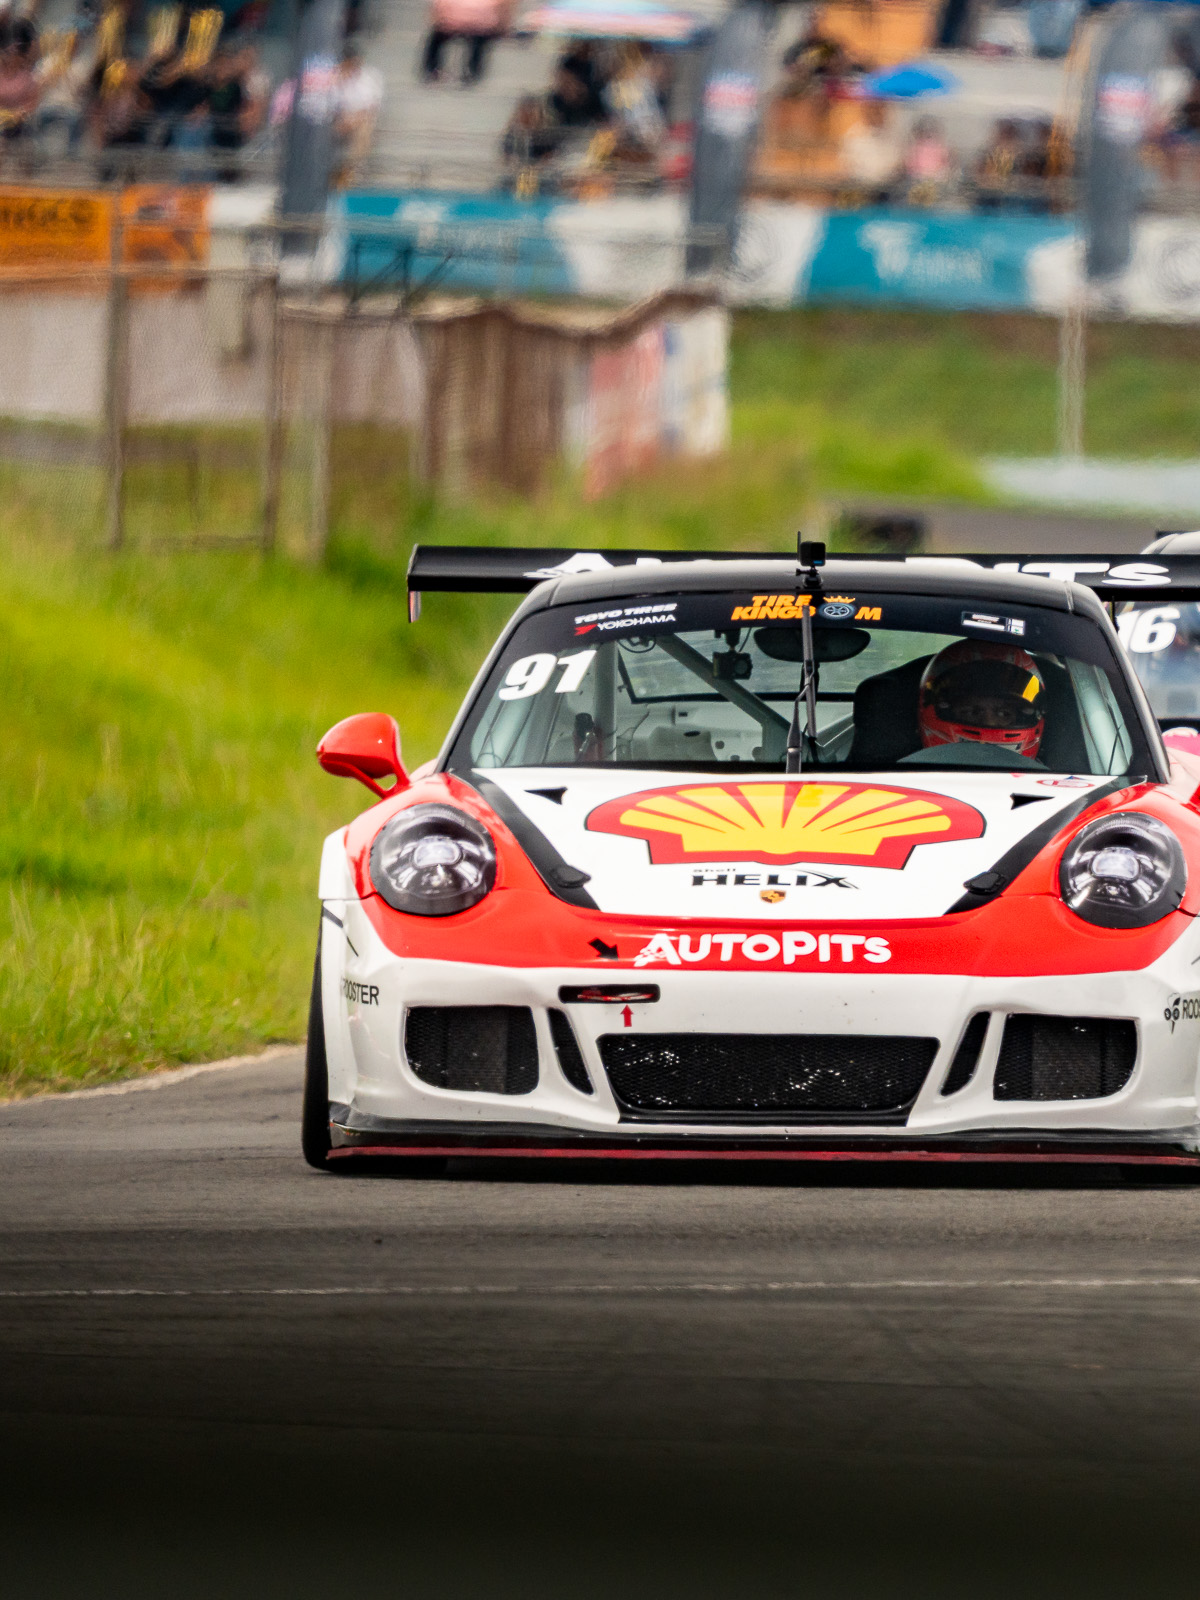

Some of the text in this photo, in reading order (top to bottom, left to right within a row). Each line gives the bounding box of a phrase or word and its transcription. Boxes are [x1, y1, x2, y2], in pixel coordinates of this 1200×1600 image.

[574, 603, 678, 625] TOYO TIRES
[597, 614, 677, 631] YOKOHAMA
[499, 650, 597, 700] 91
[692, 871, 858, 890] HELIX
[633, 931, 892, 967] AUTOPITS
